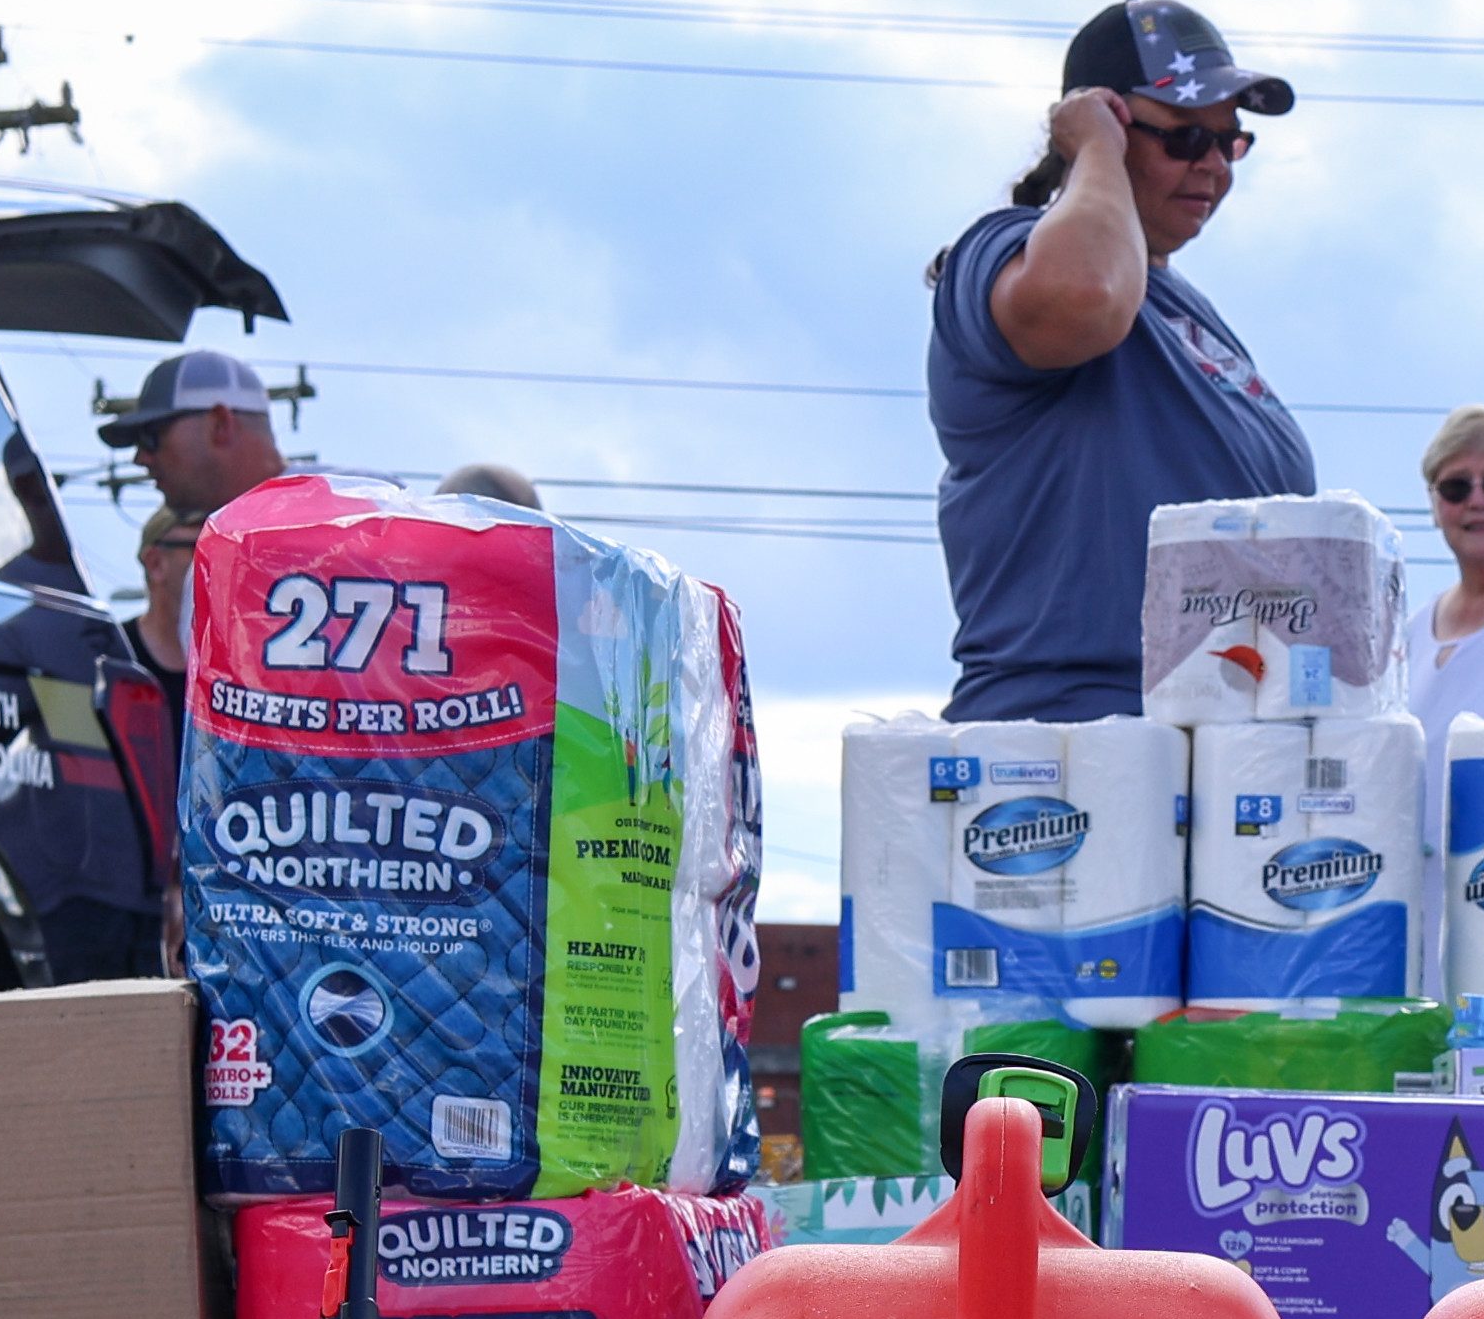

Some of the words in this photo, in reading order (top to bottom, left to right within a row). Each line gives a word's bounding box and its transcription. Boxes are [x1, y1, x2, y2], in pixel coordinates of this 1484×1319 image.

[264, 573, 453, 675] 271
[210, 680, 328, 730] SHEETS
[336, 700, 406, 732] PER
[413, 685, 524, 731] ROLL!
[215, 790, 493, 861] QUILTED
[963, 808, 1092, 855] Premium
[246, 855, 454, 893] NORTHERN
[1262, 852, 1383, 890] Premium
[209, 903, 283, 925] ULTRA
[286, 908, 347, 932] SOFT
[351, 914, 369, 932] &
[233, 926, 287, 943] LAYERS
[323, 935, 357, 950] FLEX
[360, 938, 394, 952] AND
[397, 940, 440, 955] HOLD
[443, 942, 464, 955] UP
[1255, 1199, 1358, 1218] protection
[377, 1212, 565, 1260] QUILTED
[401, 1254, 540, 1279] NORTHERN
